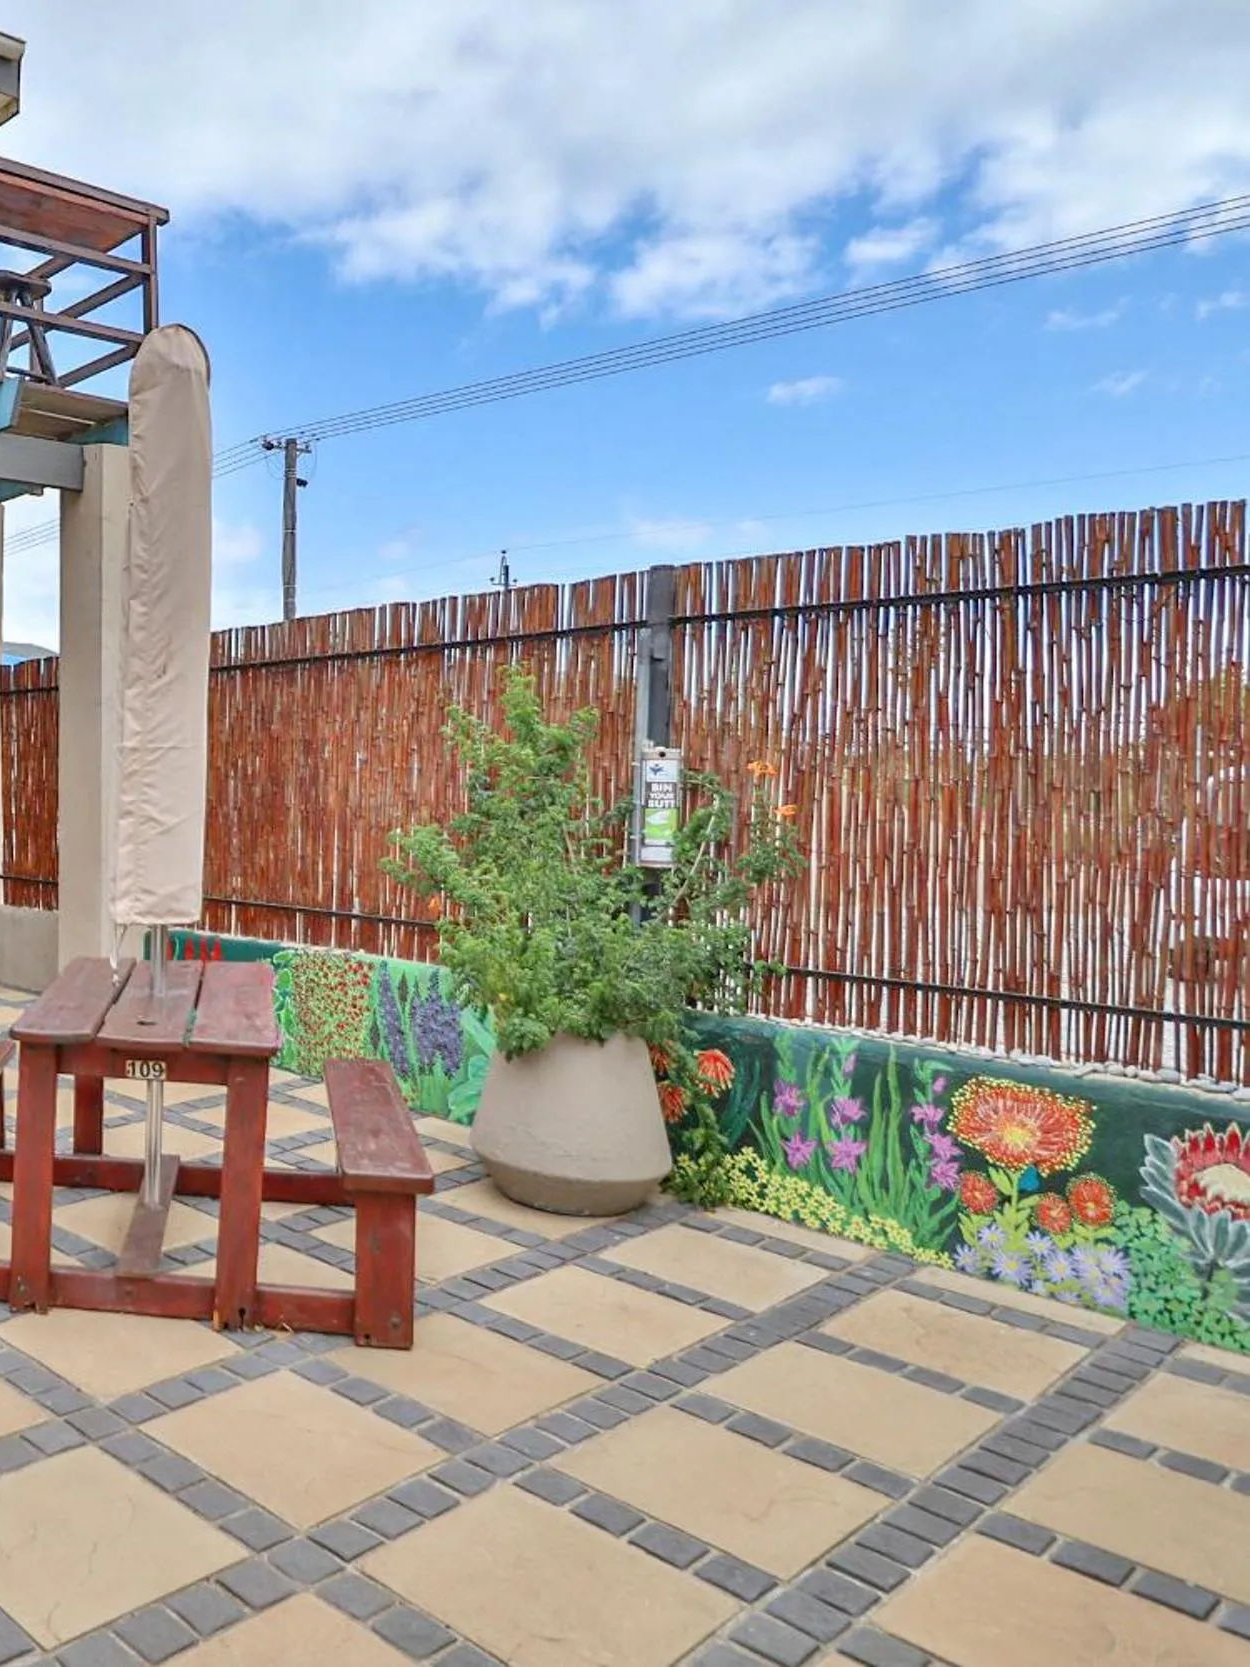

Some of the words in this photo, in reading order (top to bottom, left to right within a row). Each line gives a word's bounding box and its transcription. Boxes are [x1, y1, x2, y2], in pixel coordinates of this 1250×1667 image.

[651, 783, 673, 792] BIN
[648, 800, 675, 808] BUTT
[128, 1061, 165, 1078] 109
